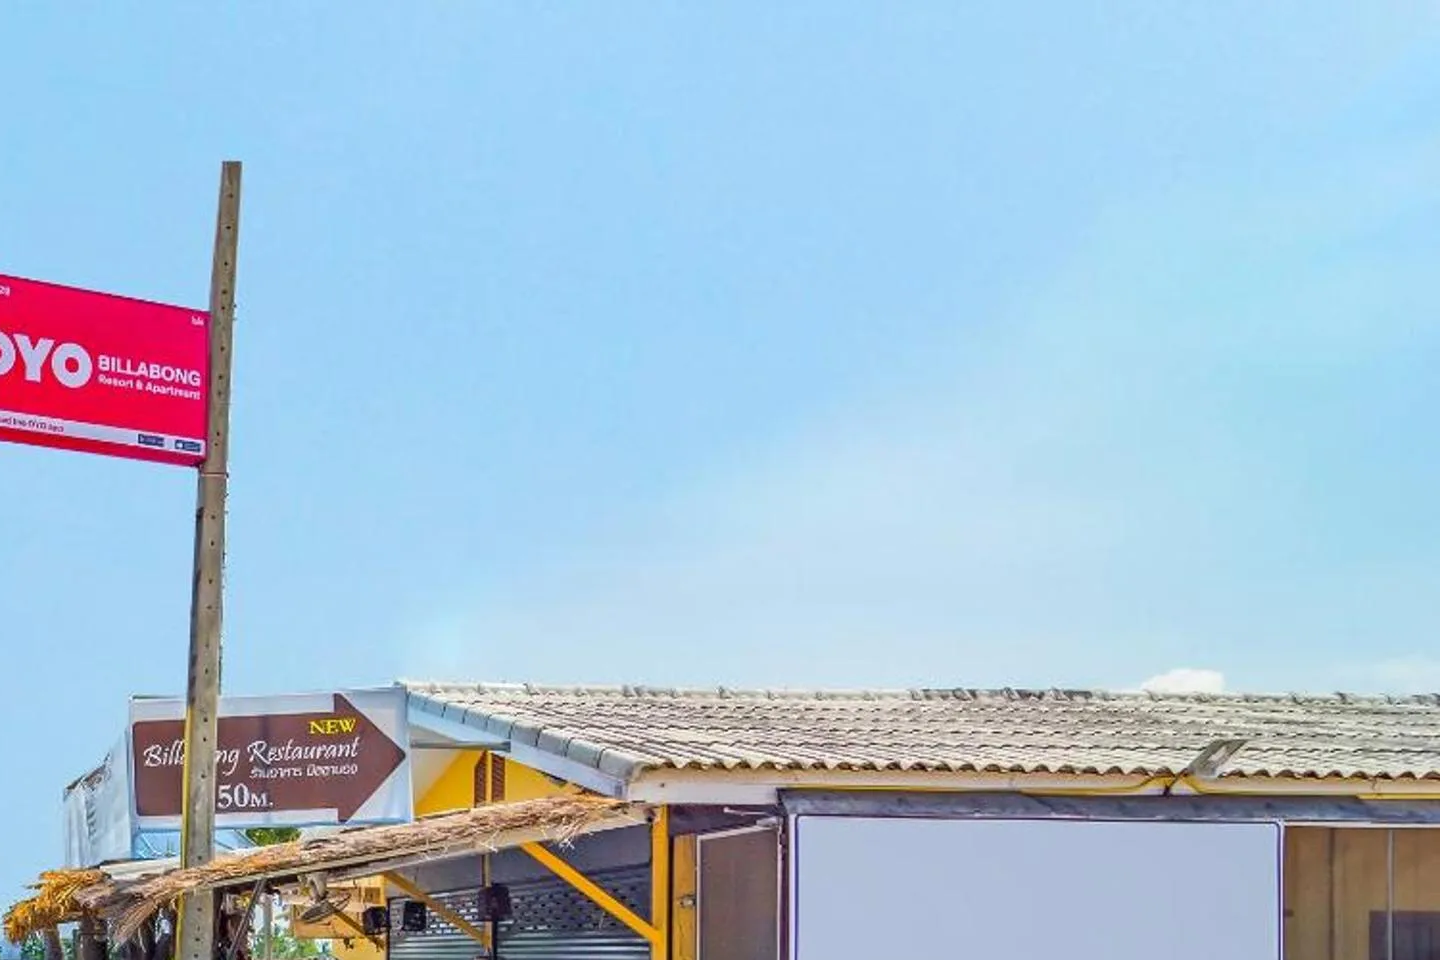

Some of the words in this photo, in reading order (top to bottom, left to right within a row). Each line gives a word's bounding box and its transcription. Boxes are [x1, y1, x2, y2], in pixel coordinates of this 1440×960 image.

[98, 355, 201, 386] BILLABONG
[97, 374, 134, 389] Resort
[145, 382, 201, 401] Apartment
[310, 718, 356, 736] NEW
[247, 738, 359, 764] Restaurant
